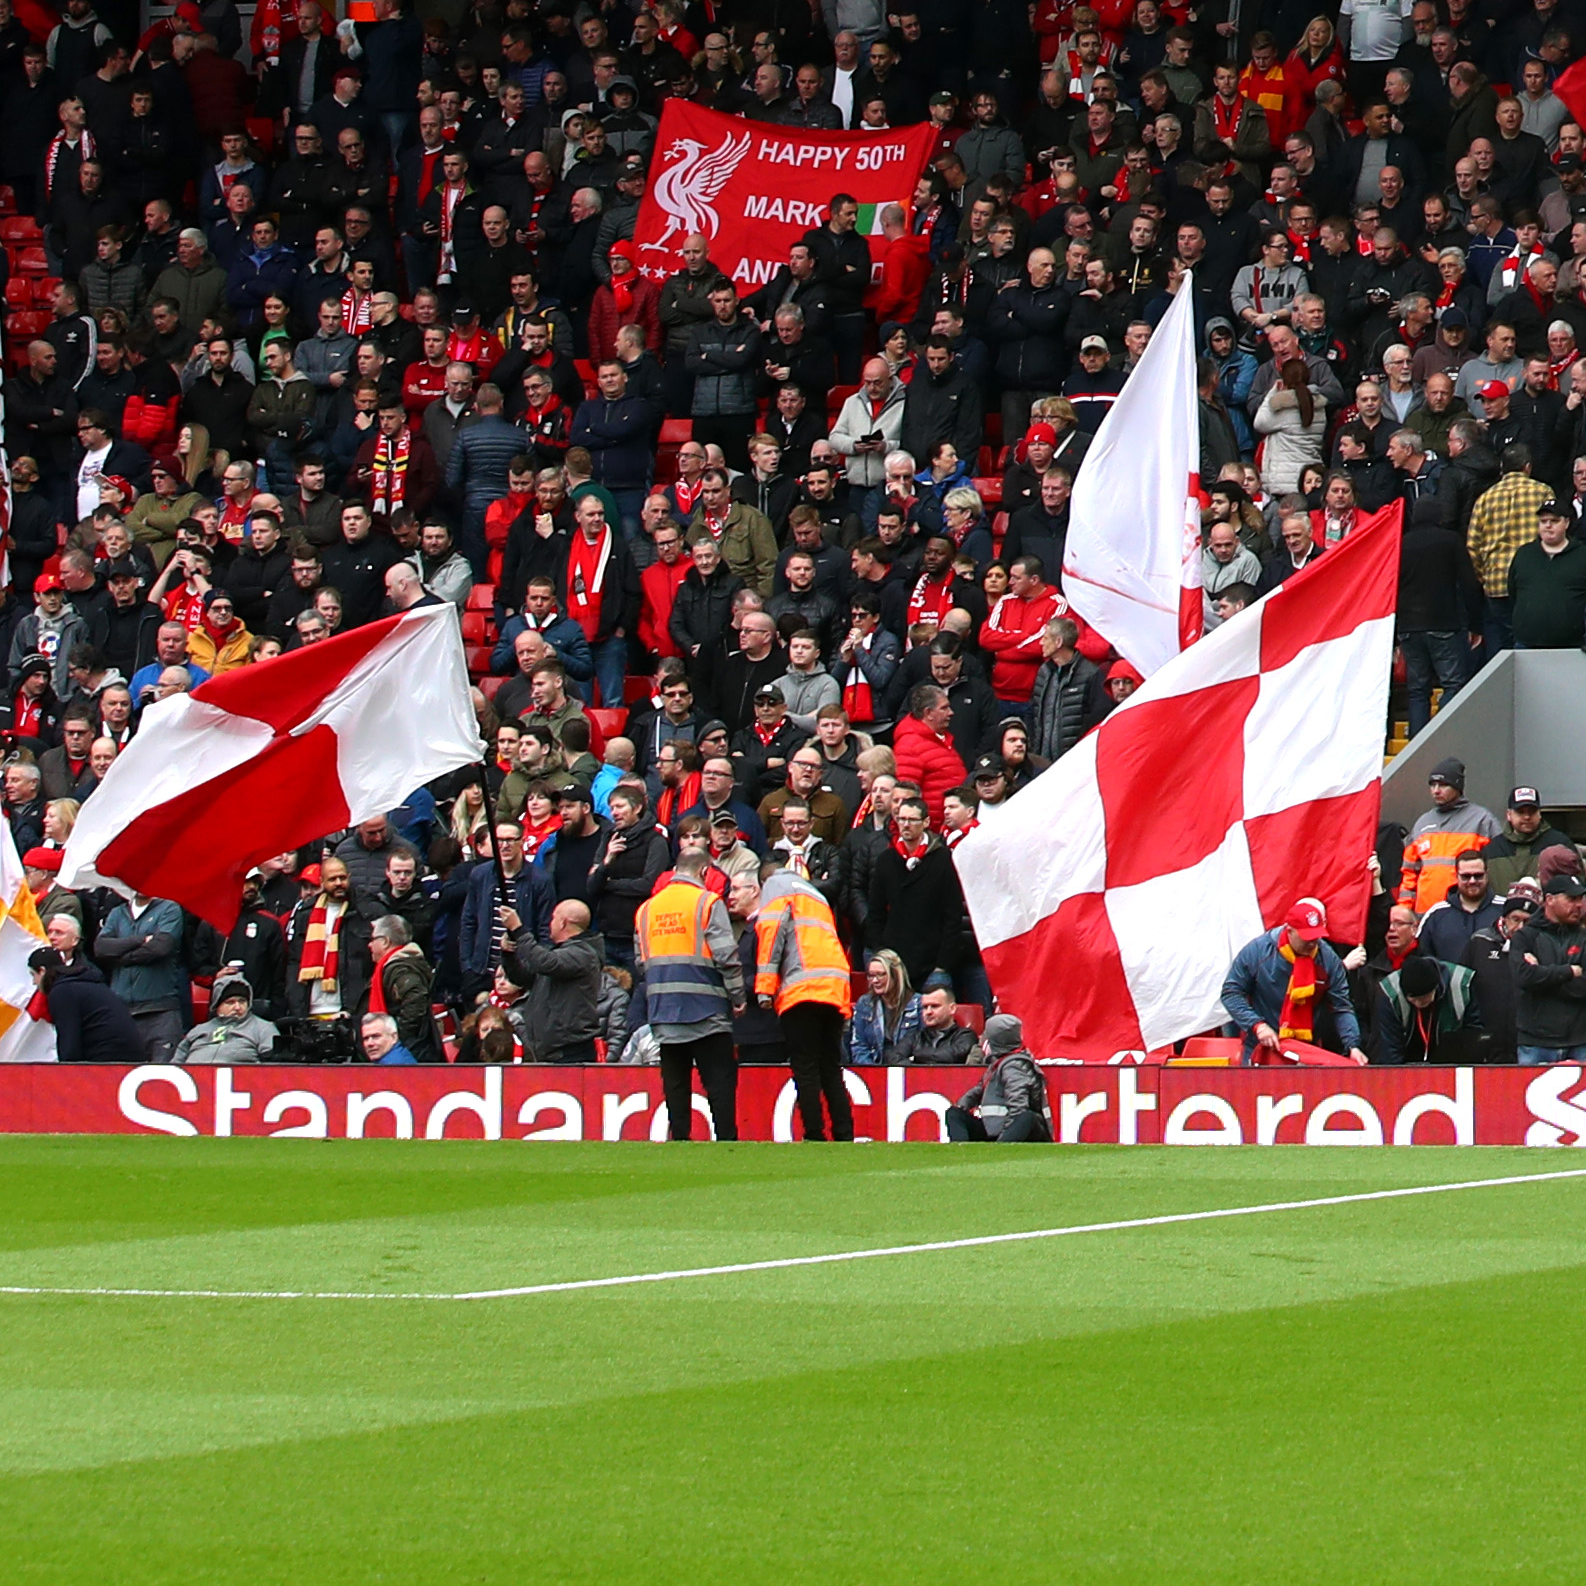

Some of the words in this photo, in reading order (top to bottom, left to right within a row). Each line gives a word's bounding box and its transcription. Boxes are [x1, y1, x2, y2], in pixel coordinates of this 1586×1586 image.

[757, 138, 851, 171] HAPPY
[855, 144, 905, 172] 50TH
[743, 195, 828, 228] MARK
[771, 1065, 1473, 1145] Chrtered
